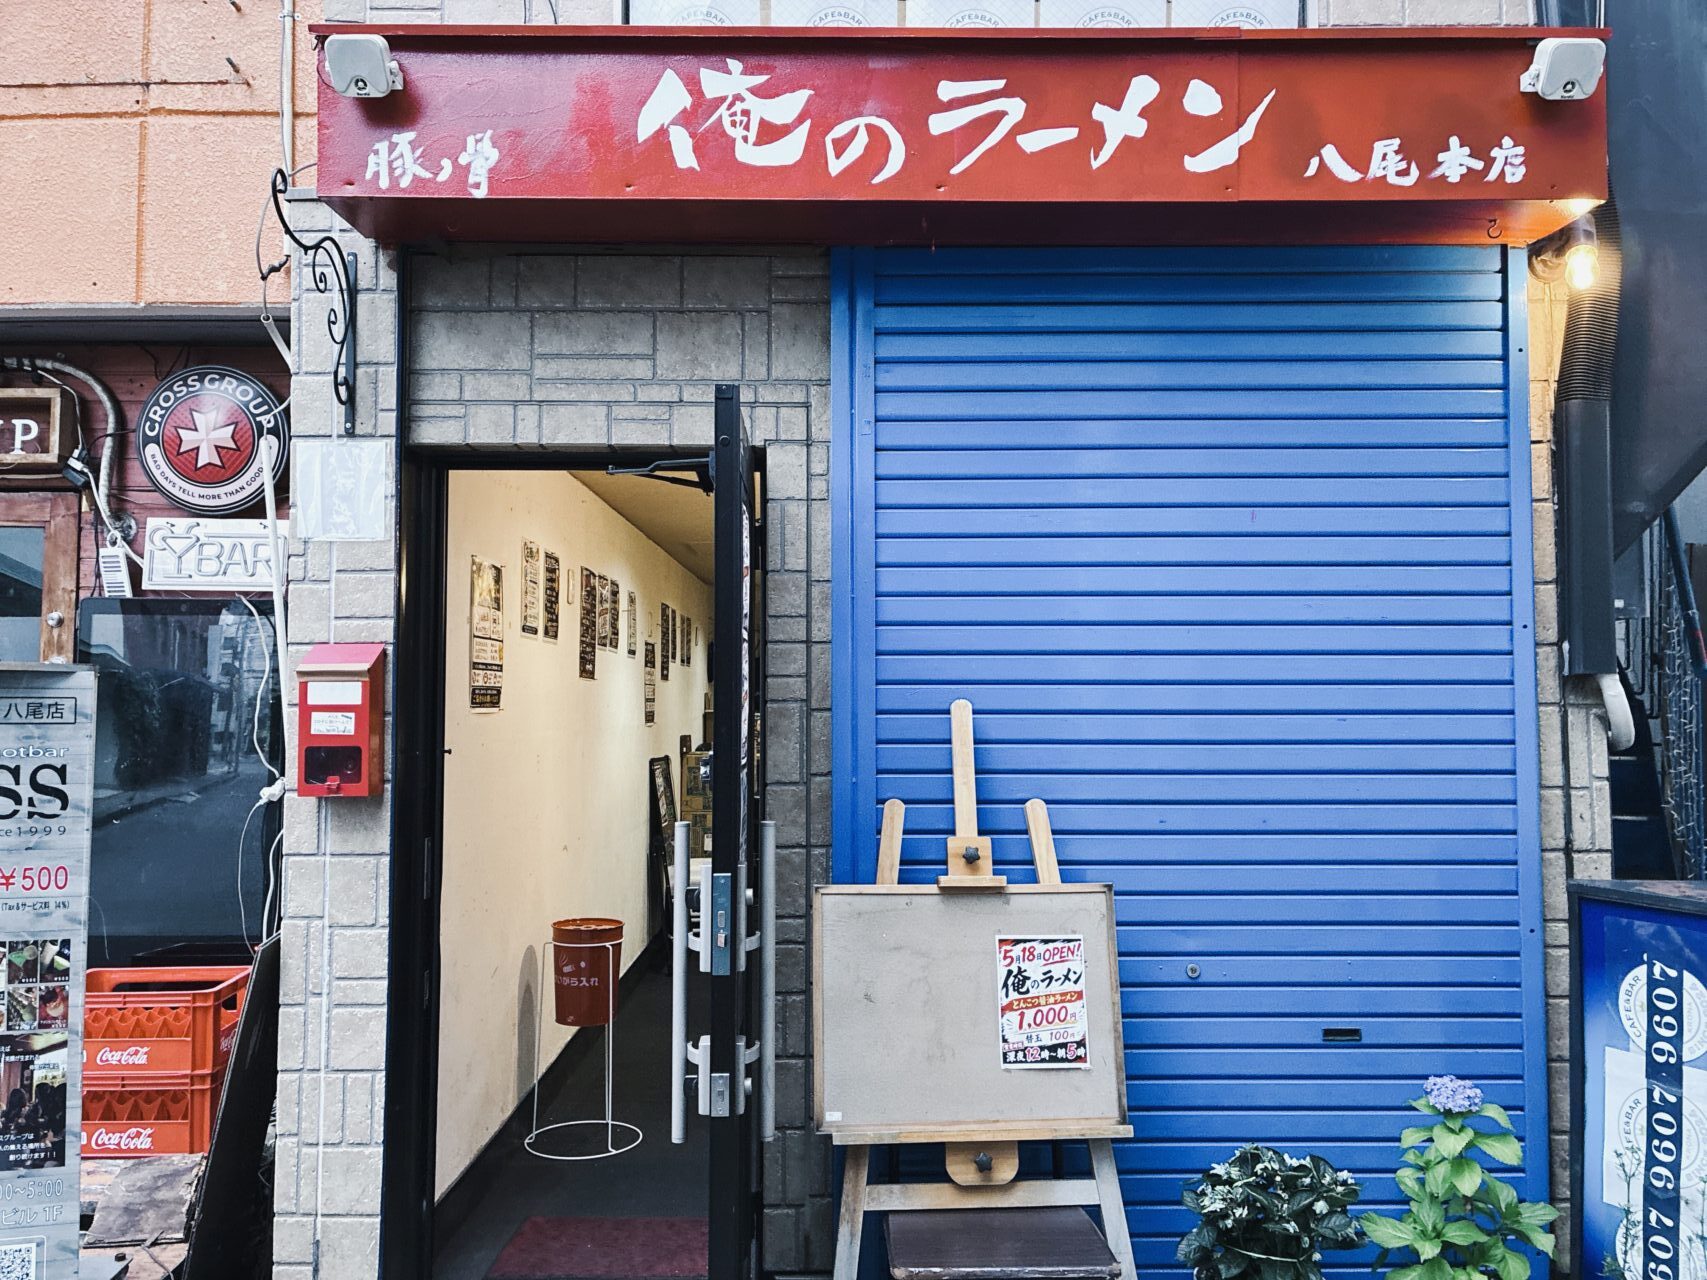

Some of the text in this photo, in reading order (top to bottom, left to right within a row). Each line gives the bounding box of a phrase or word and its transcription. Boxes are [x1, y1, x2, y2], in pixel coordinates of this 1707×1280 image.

[637, 58, 1276, 184] 俺のラーメン
[1303, 135, 1526, 186] 八尾本店
[145, 374, 274, 437] CROSS GROUP
[160, 470, 176, 488] DAYS
[178, 486, 196, 498] TELL
[198, 492, 222, 500] MORE
[224, 485, 246, 498] THAN
[195, 541, 273, 577] BAR
[3, 701, 65, 720] 八尾店
[1003, 943, 1082, 967] 5月18日 OPEN!
[1001, 966, 1083, 998] 俺のラーメン
[1018, 1005, 1077, 1031] 1,000円
[96, 1046, 151, 1065] Coca-Cola
[91, 1127, 155, 1150] Coca-Cola
[43, 1204, 63, 1222] 1F
